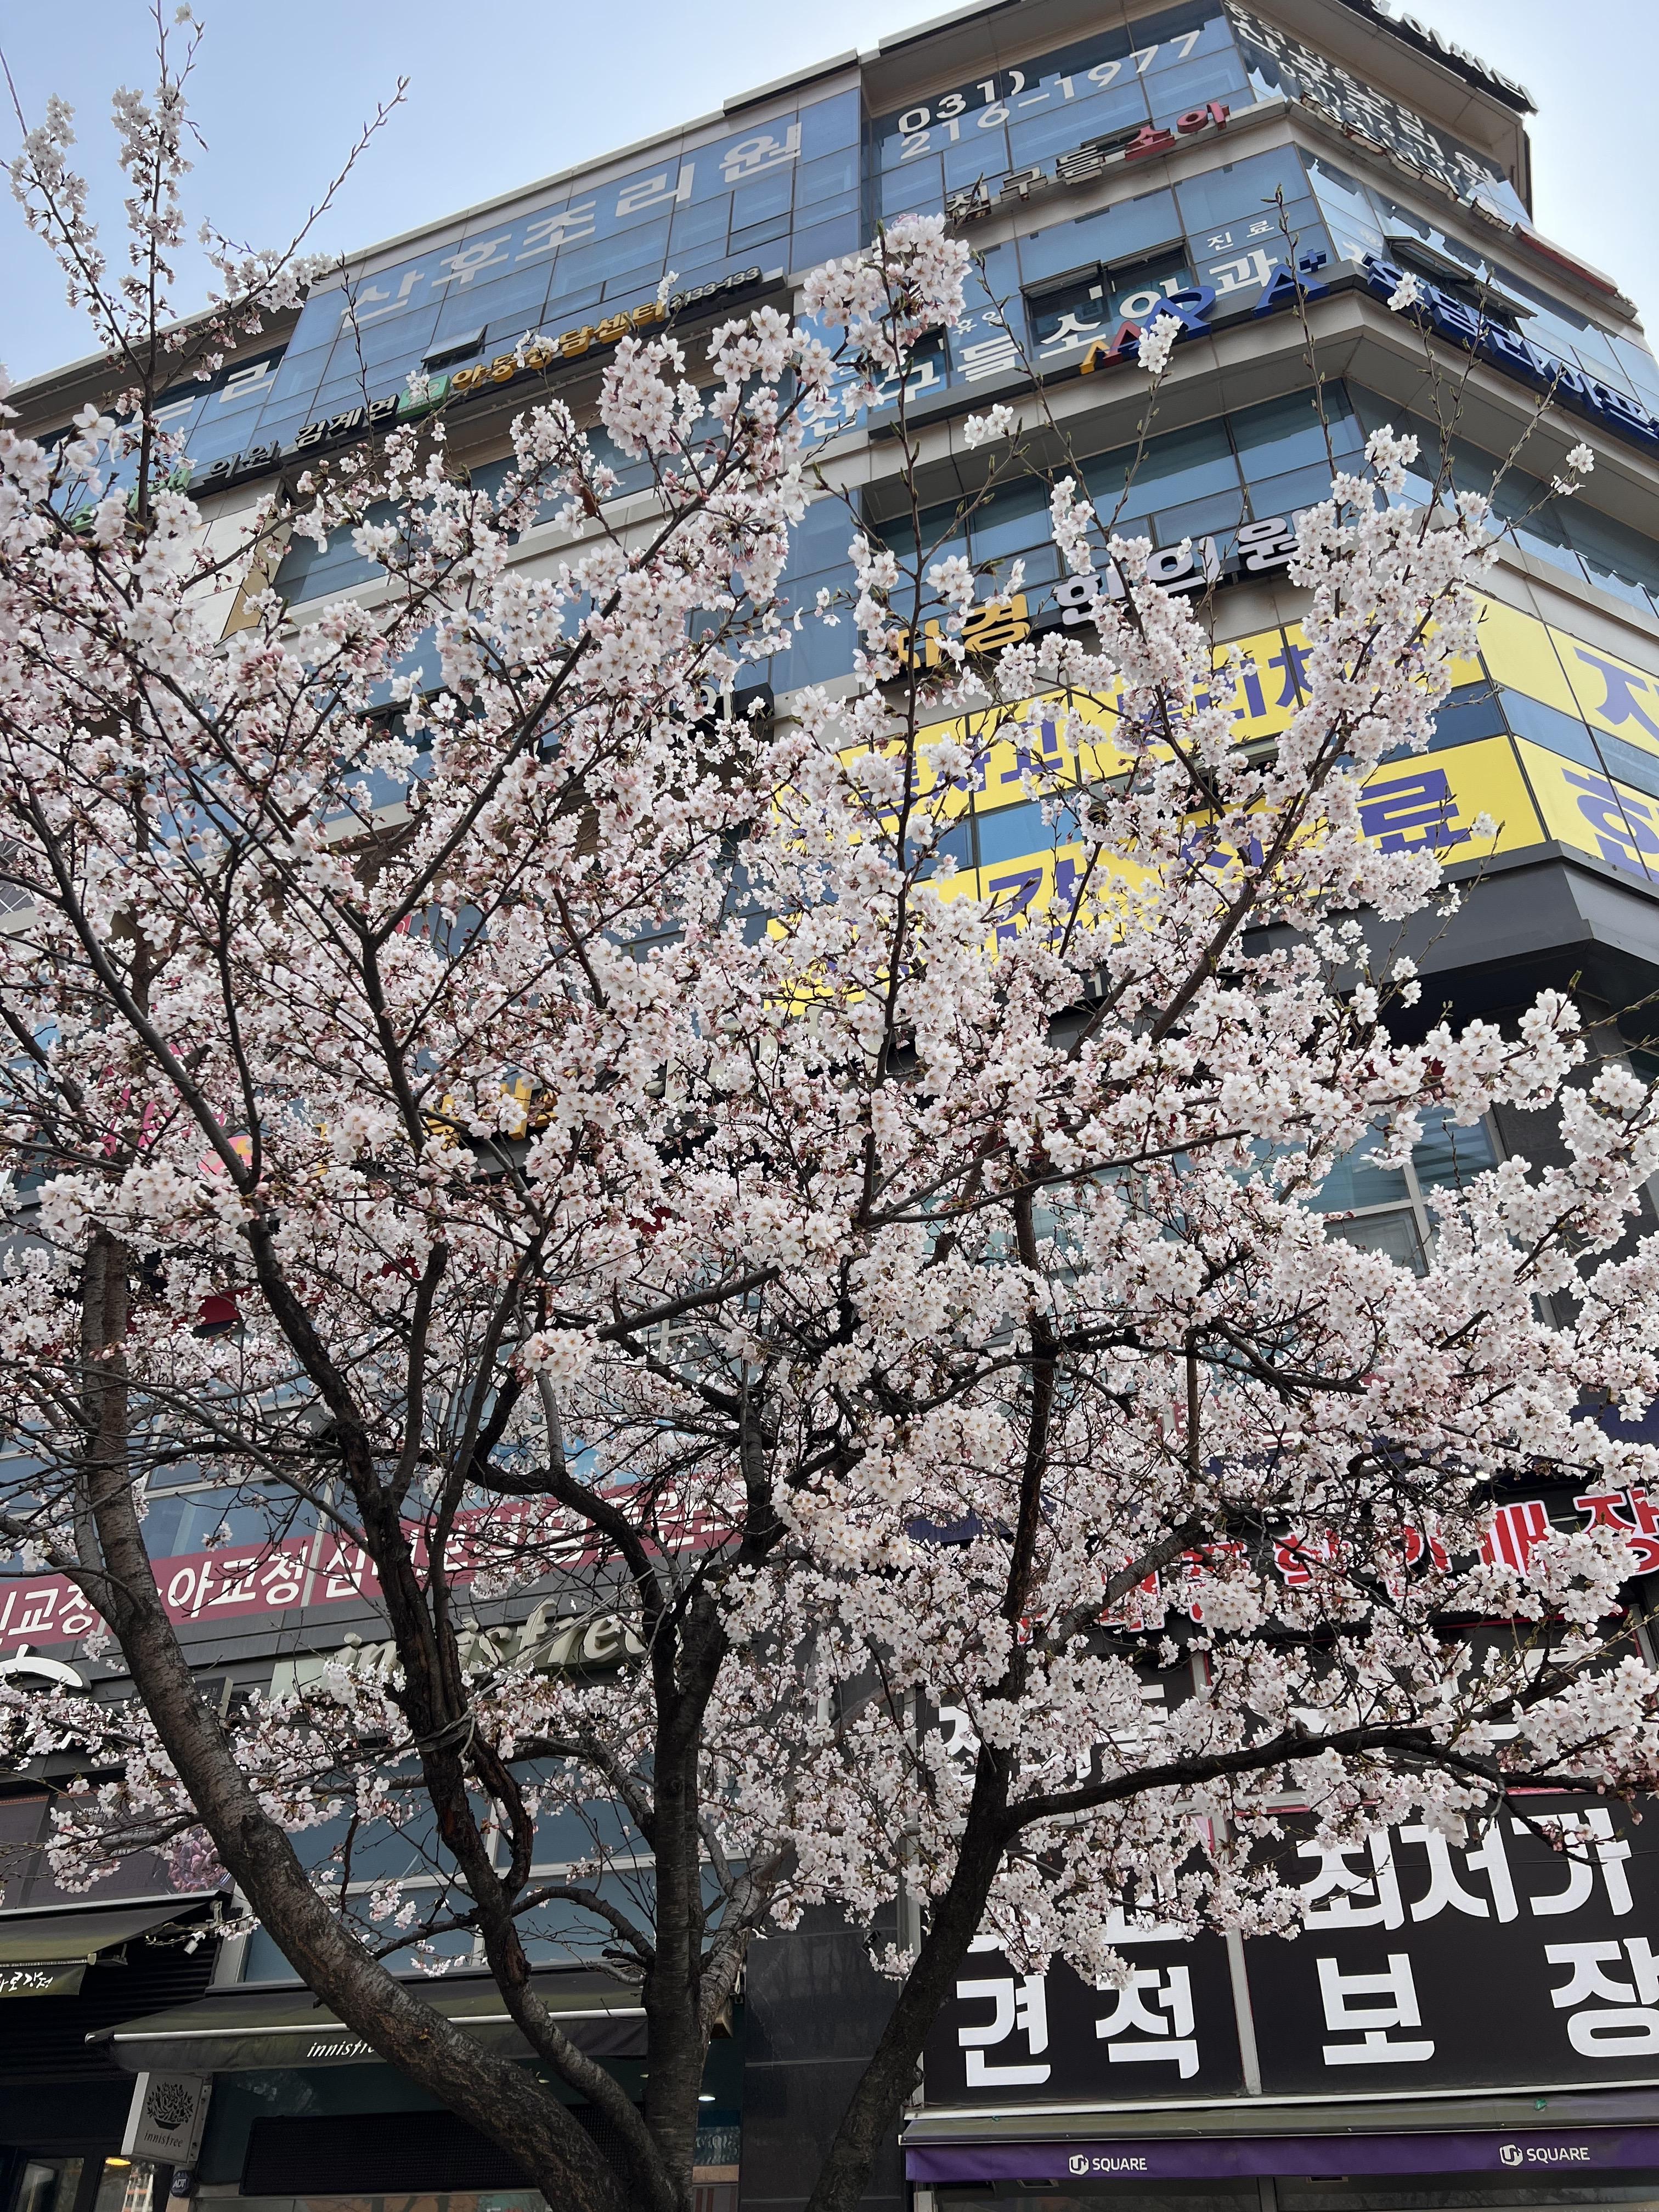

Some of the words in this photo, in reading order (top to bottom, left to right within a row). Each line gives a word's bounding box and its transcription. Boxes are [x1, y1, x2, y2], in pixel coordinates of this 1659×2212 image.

[898, 70, 1025, 134] 031)
[900, 30, 1201, 160] 216-1977
[1232, 20, 1500, 191] 산후조리원
[1125, 101, 1231, 161] 소아
[341, 121, 802, 329] 산후조리원
[953, 308, 1004, 336] 휴일
[1207, 219, 1275, 251] 진료
[296, 393, 399, 448] 김계연
[210, 440, 278, 478] 의원
[158, 1546, 308, 1618] 아교정
[1296, 1808, 1633, 1931] 최저가
[307, 2039, 375, 2057] innisfr
[144, 2130, 184, 2147] innisfree
[1092, 2158, 1148, 2172] SQUARE
[1526, 2147, 1590, 2164] SQUARE
[172, 2178, 187, 2188] ADT
